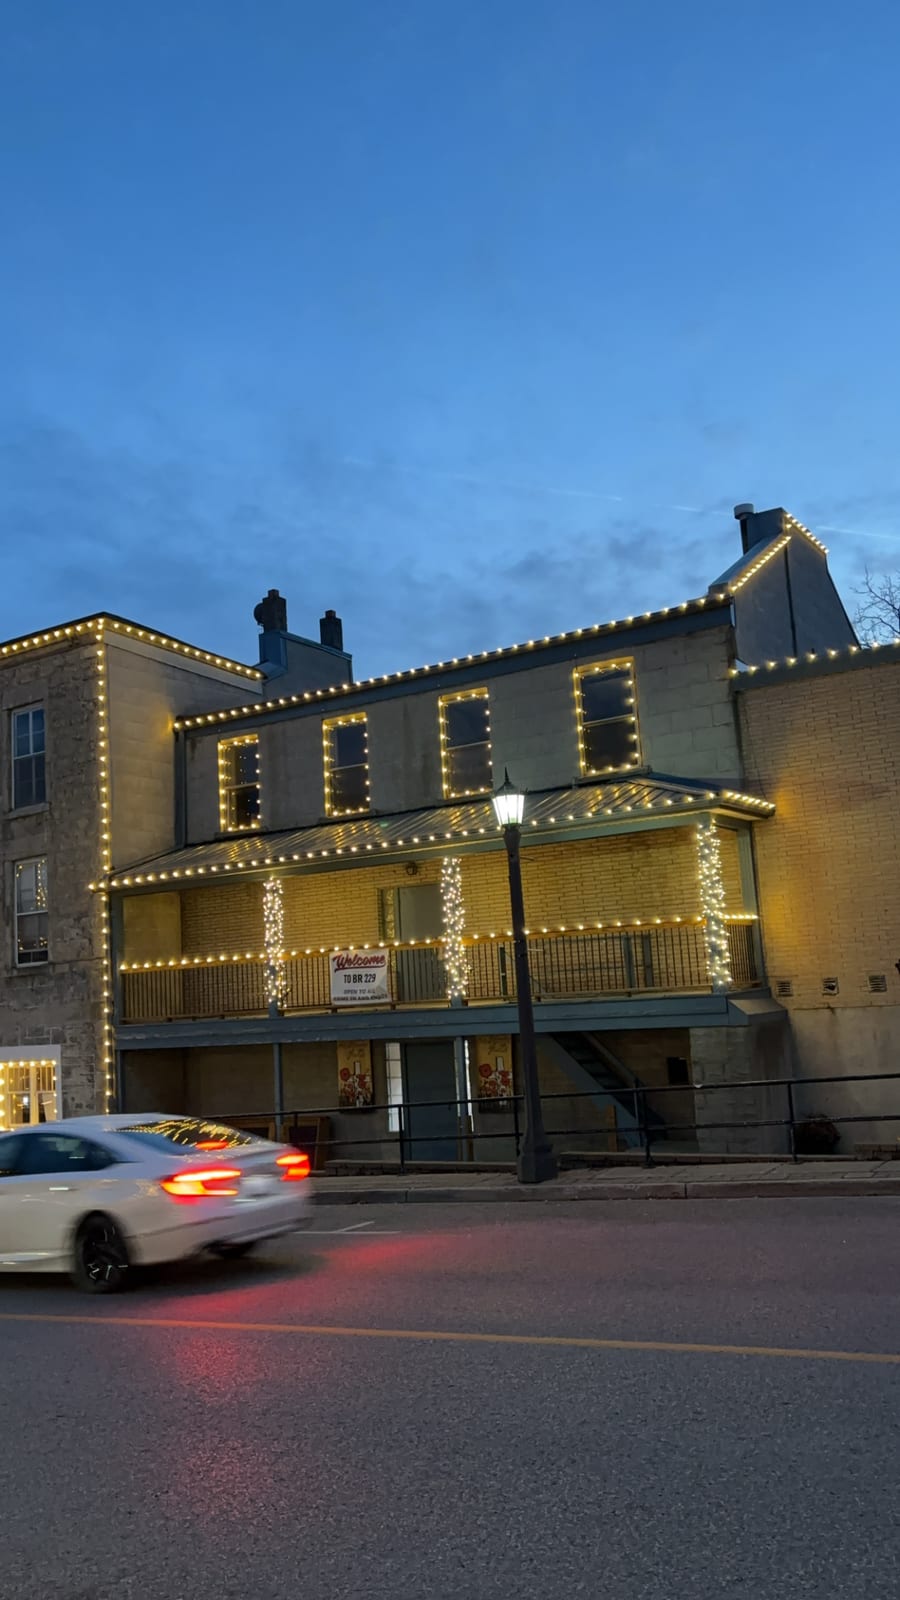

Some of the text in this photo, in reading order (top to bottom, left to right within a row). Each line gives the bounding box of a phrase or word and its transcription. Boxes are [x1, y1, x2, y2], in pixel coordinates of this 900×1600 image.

[332, 953, 386, 970] Welcome
[343, 973, 377, 984] TO BR 229
